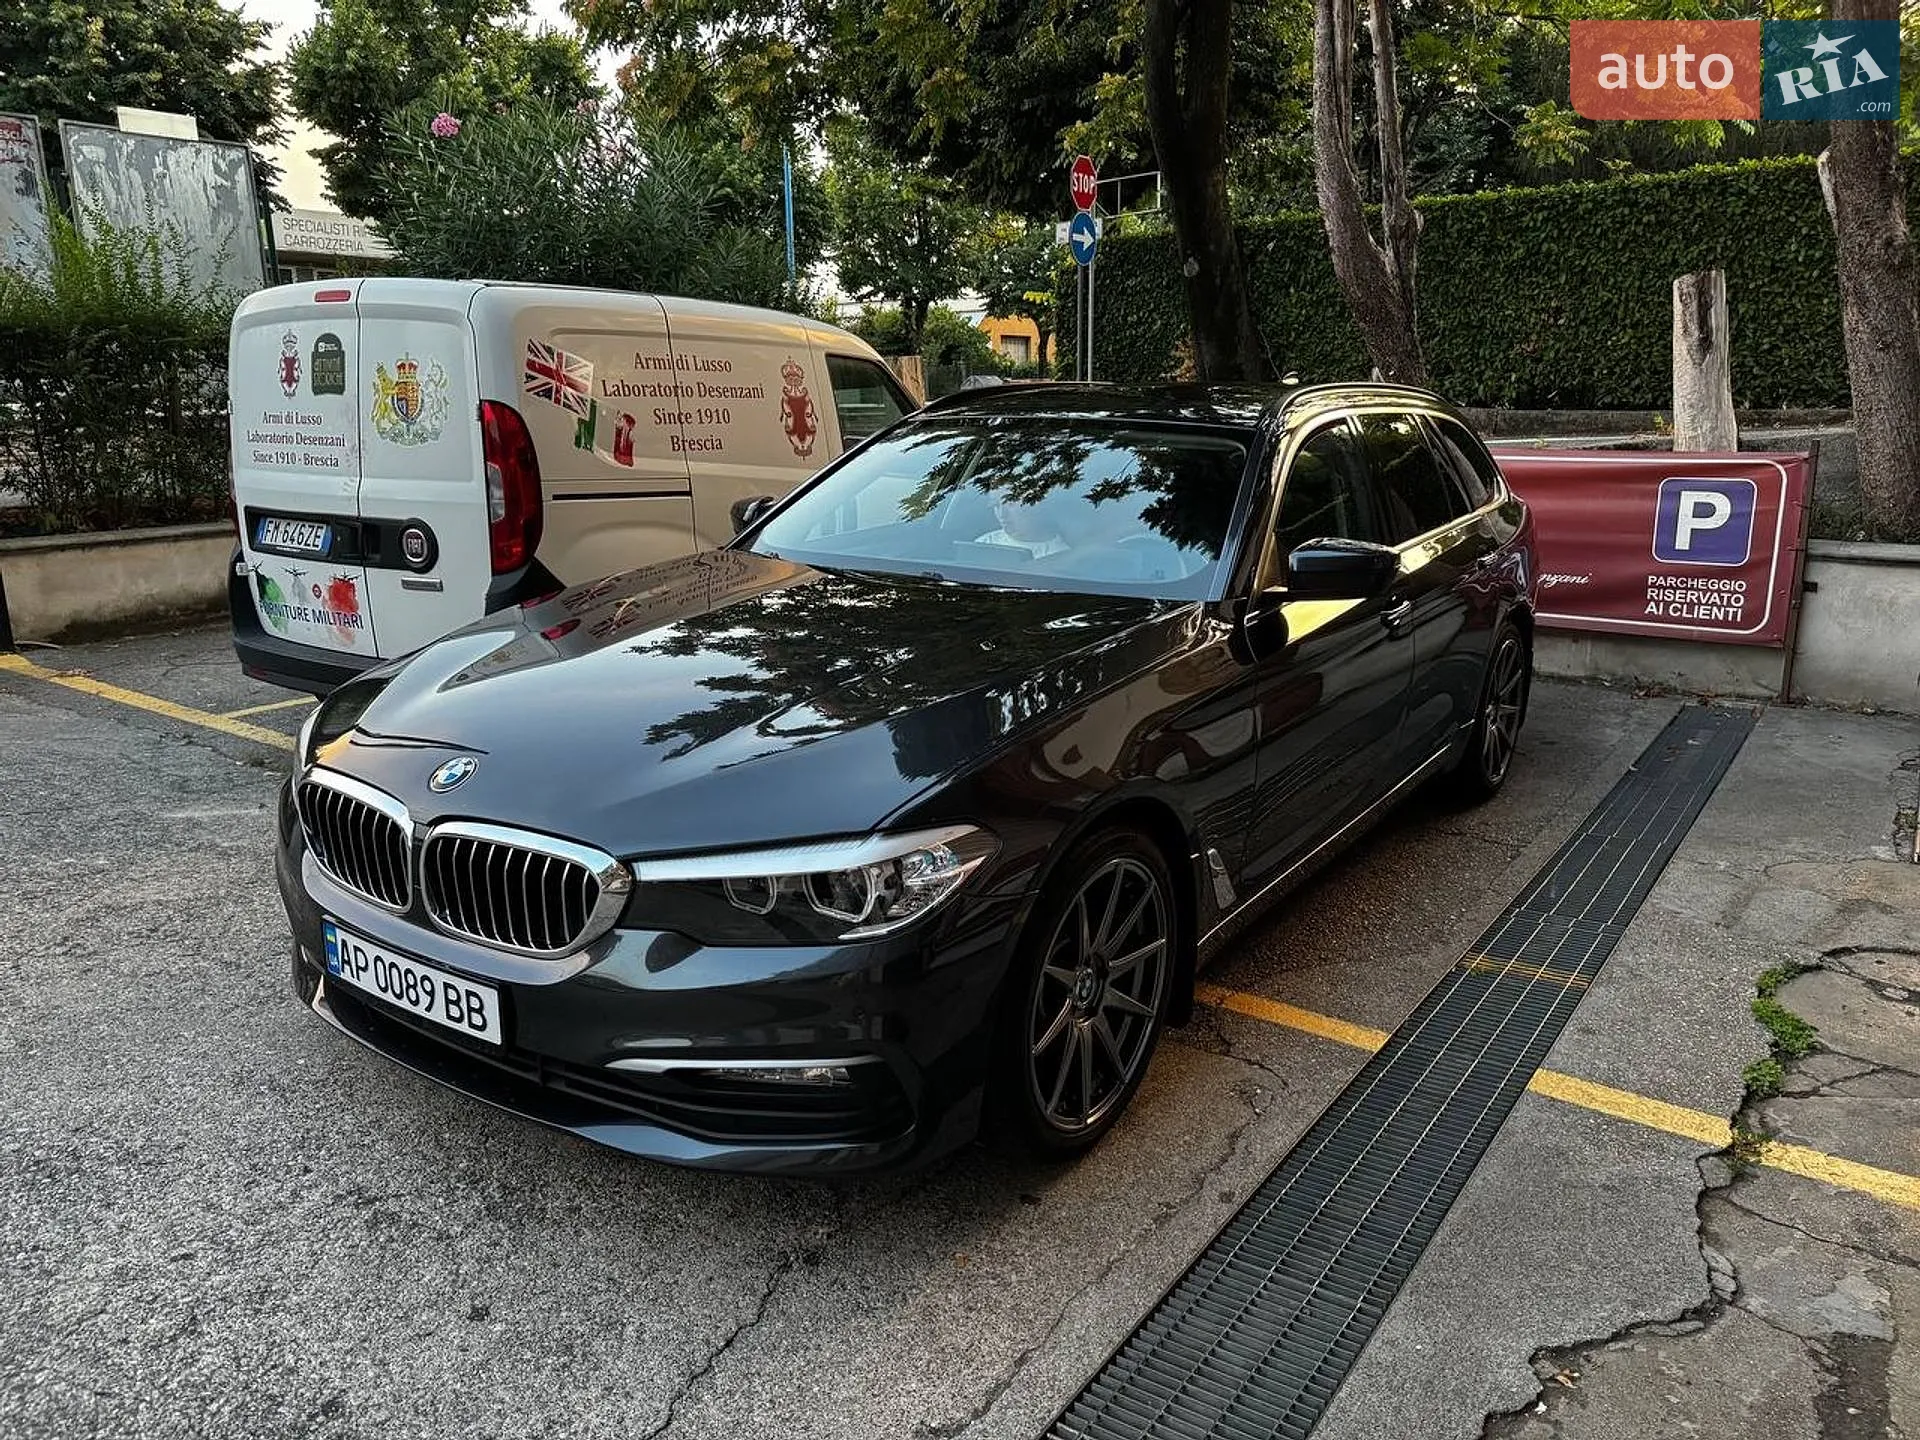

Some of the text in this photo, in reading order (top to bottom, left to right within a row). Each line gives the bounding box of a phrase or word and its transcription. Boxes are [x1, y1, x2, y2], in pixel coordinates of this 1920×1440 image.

[1072, 172, 1095, 194] STOP
[282, 218, 351, 237] SPECIALISTI
[284, 234, 364, 252] CARROZZERIA
[634, 352, 732, 373] Armi di Lusso
[601, 379, 765, 399] Laboratorio Desenzani
[263, 411, 322, 426] Armi di Lusso
[653, 408, 731, 425] Since 1910
[247, 430, 345, 447] Laboratorio Desenzani
[670, 435, 723, 452] Brescia
[253, 450, 274, 464] Since
[275, 451, 297, 465] 1910
[303, 453, 339, 468] Brescia
[1675, 491, 1731, 550] P
[1647, 576, 1747, 592] PARCHEGGIO
[1647, 588, 1745, 607] RISERVATO
[312, 608, 364, 629] MILITARI
[1644, 601, 1742, 622] AI CLIENTI
[340, 938, 487, 1032] AP 0089 BB
